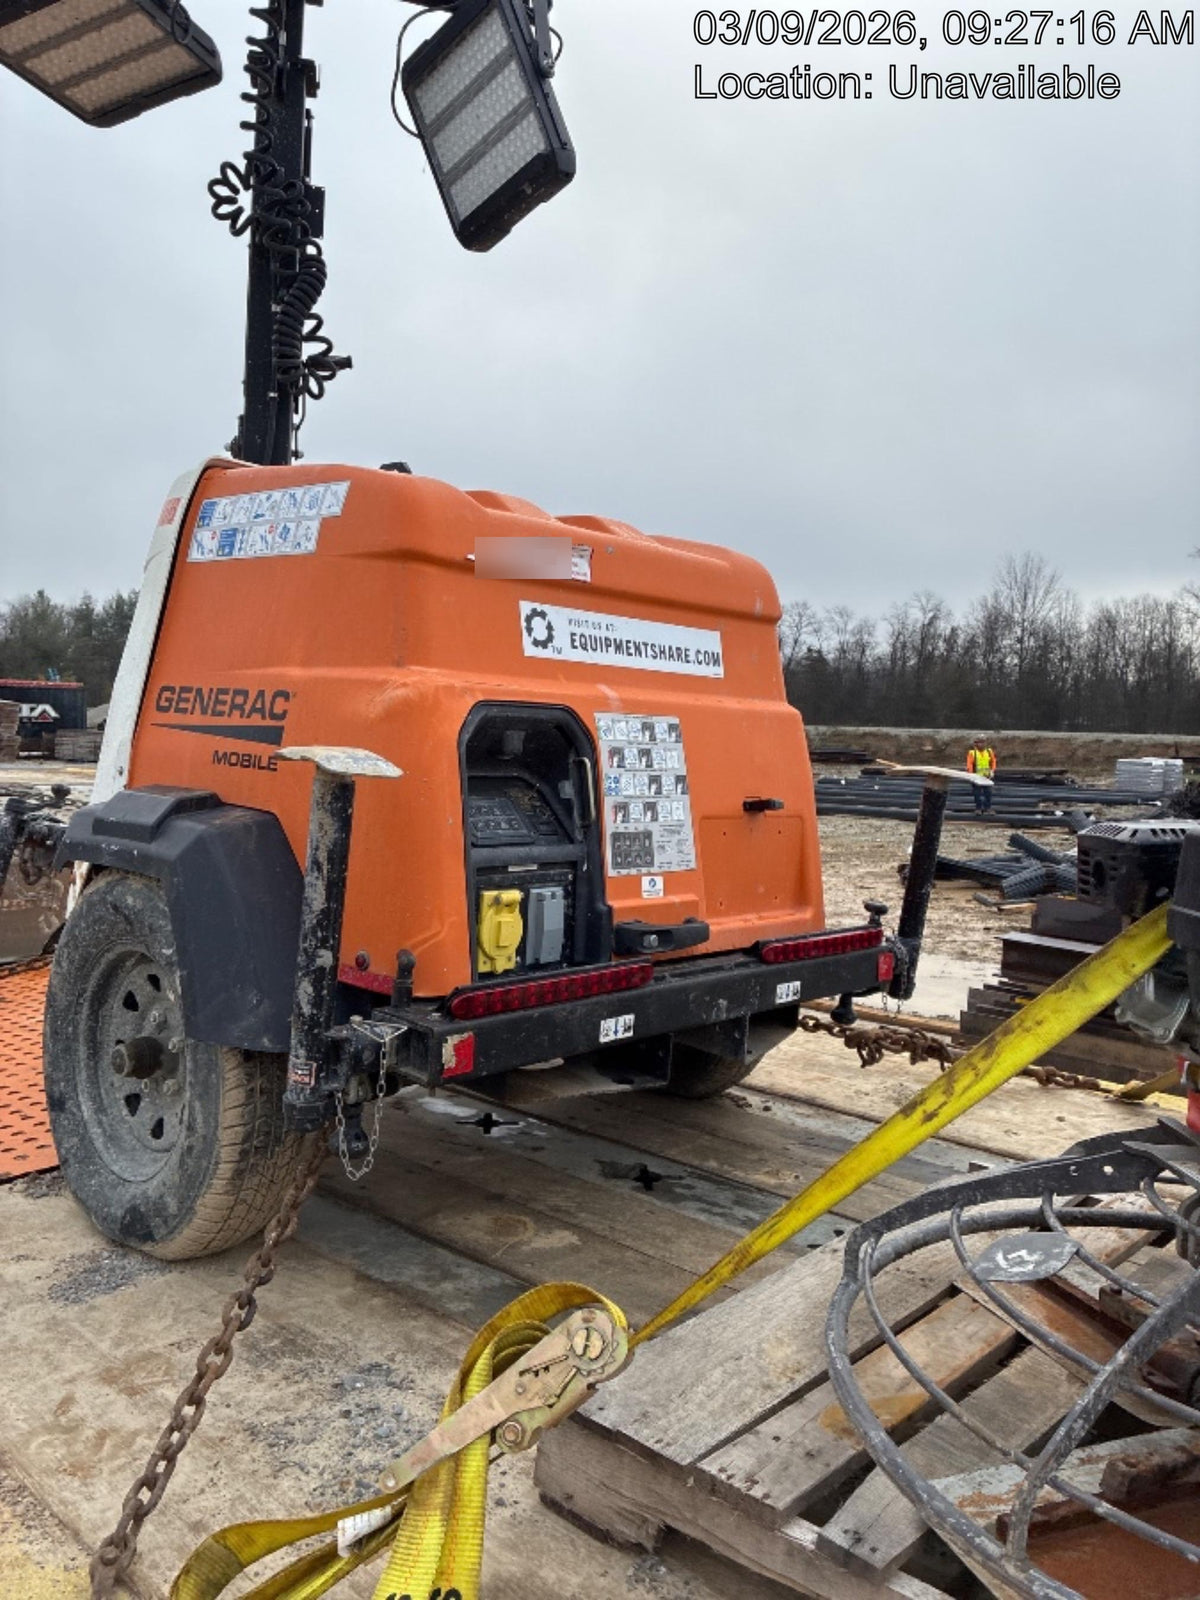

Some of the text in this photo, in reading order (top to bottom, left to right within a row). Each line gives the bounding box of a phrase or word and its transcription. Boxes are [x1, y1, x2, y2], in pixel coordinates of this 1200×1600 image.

[569, 632, 721, 668] EQUIPMENTSHARE.COM
[155, 685, 291, 721] GENERAC
[212, 750, 278, 772] MOBILE
